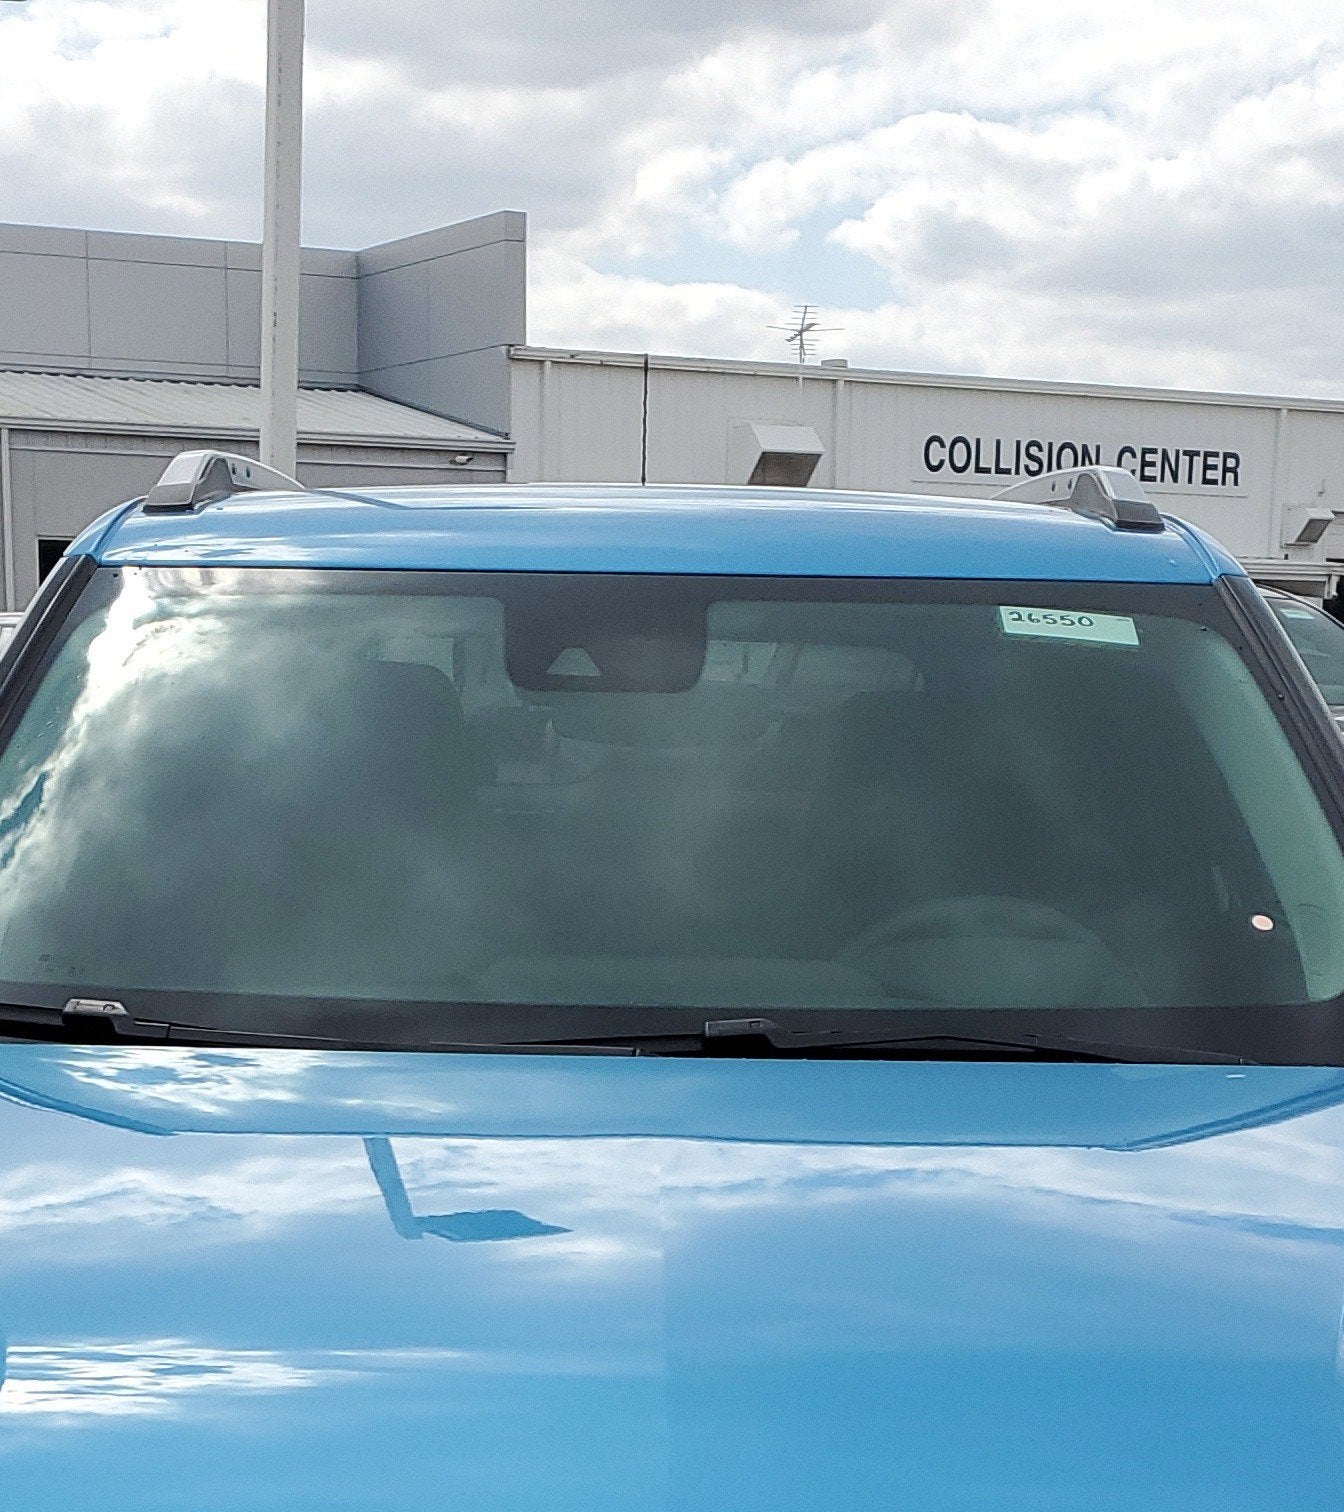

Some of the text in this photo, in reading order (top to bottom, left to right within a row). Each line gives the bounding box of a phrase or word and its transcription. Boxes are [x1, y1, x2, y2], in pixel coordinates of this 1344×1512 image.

[923, 434, 1241, 487] COLLISION CENTER
[1008, 610, 1094, 627] 26550
